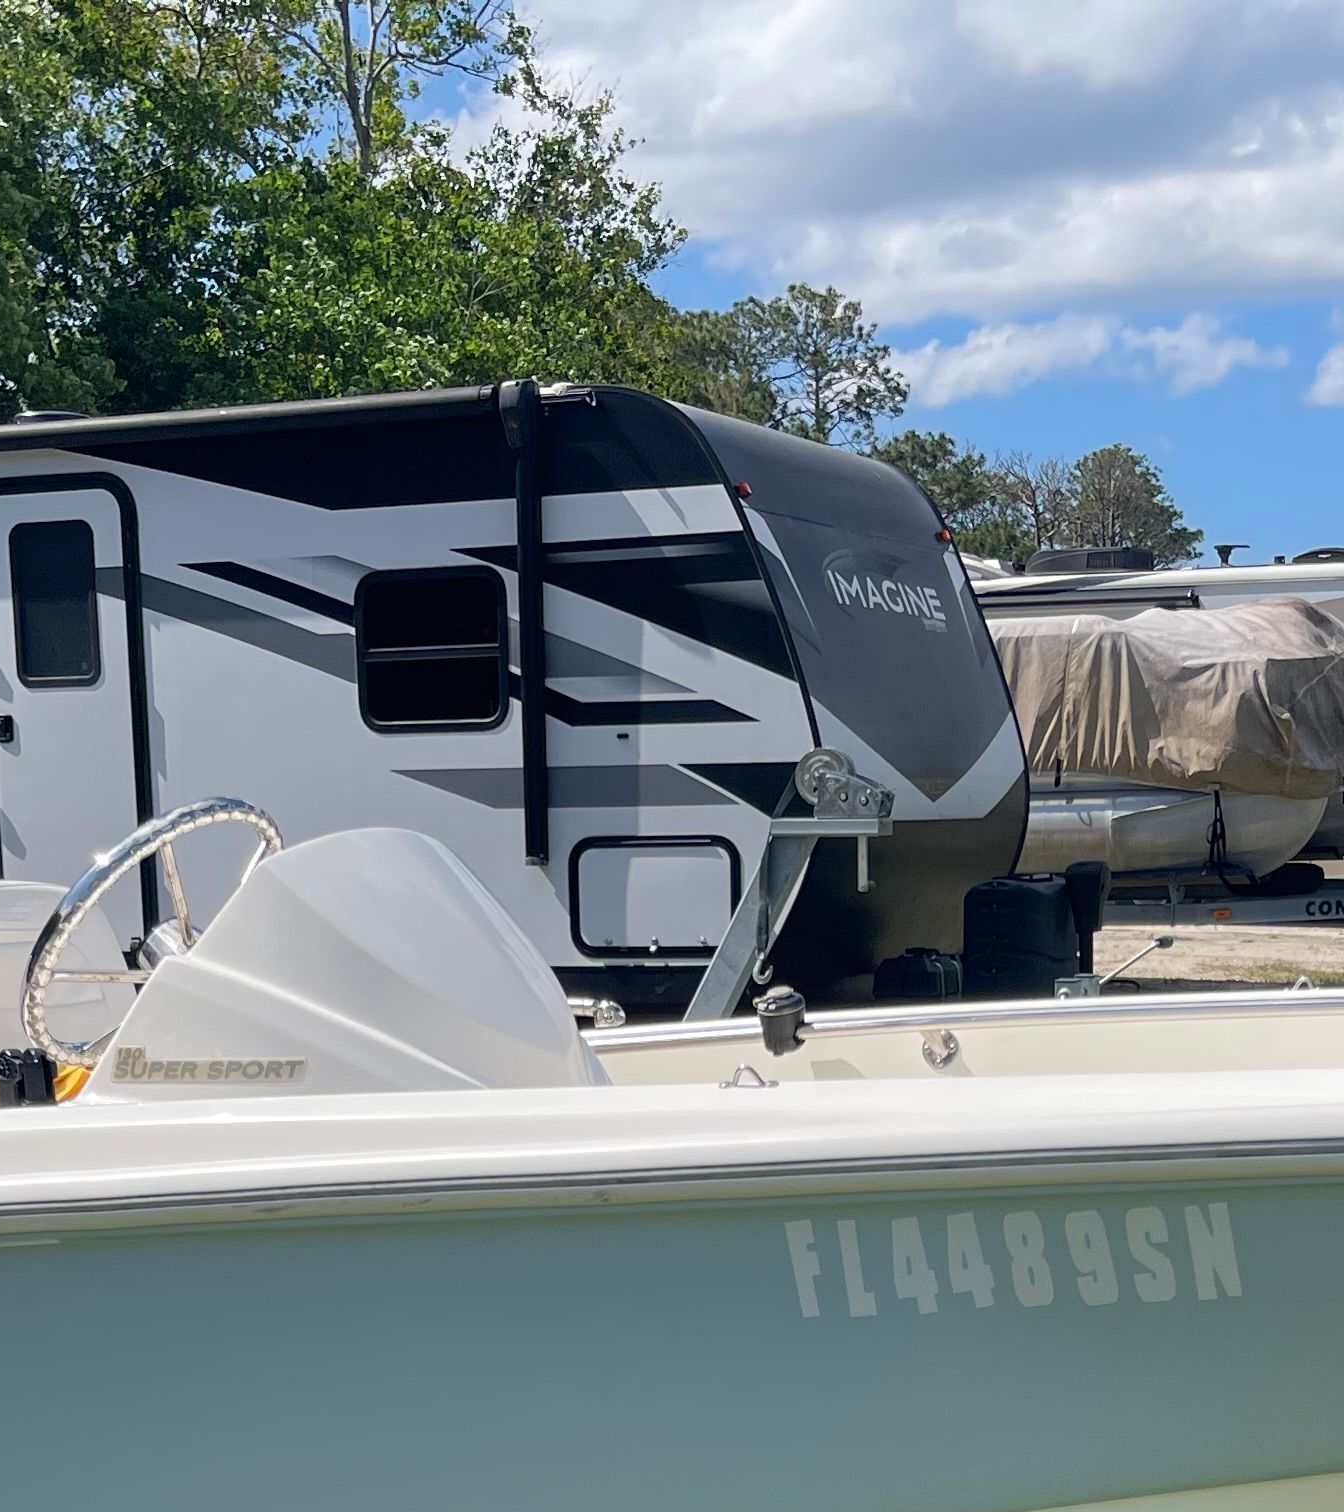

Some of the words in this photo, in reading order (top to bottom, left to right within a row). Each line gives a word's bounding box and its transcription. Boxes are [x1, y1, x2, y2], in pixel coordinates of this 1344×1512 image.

[826, 569, 947, 621] IMAGINE
[113, 1060, 198, 1080] SUPER
[206, 1059, 305, 1080] SPORT
